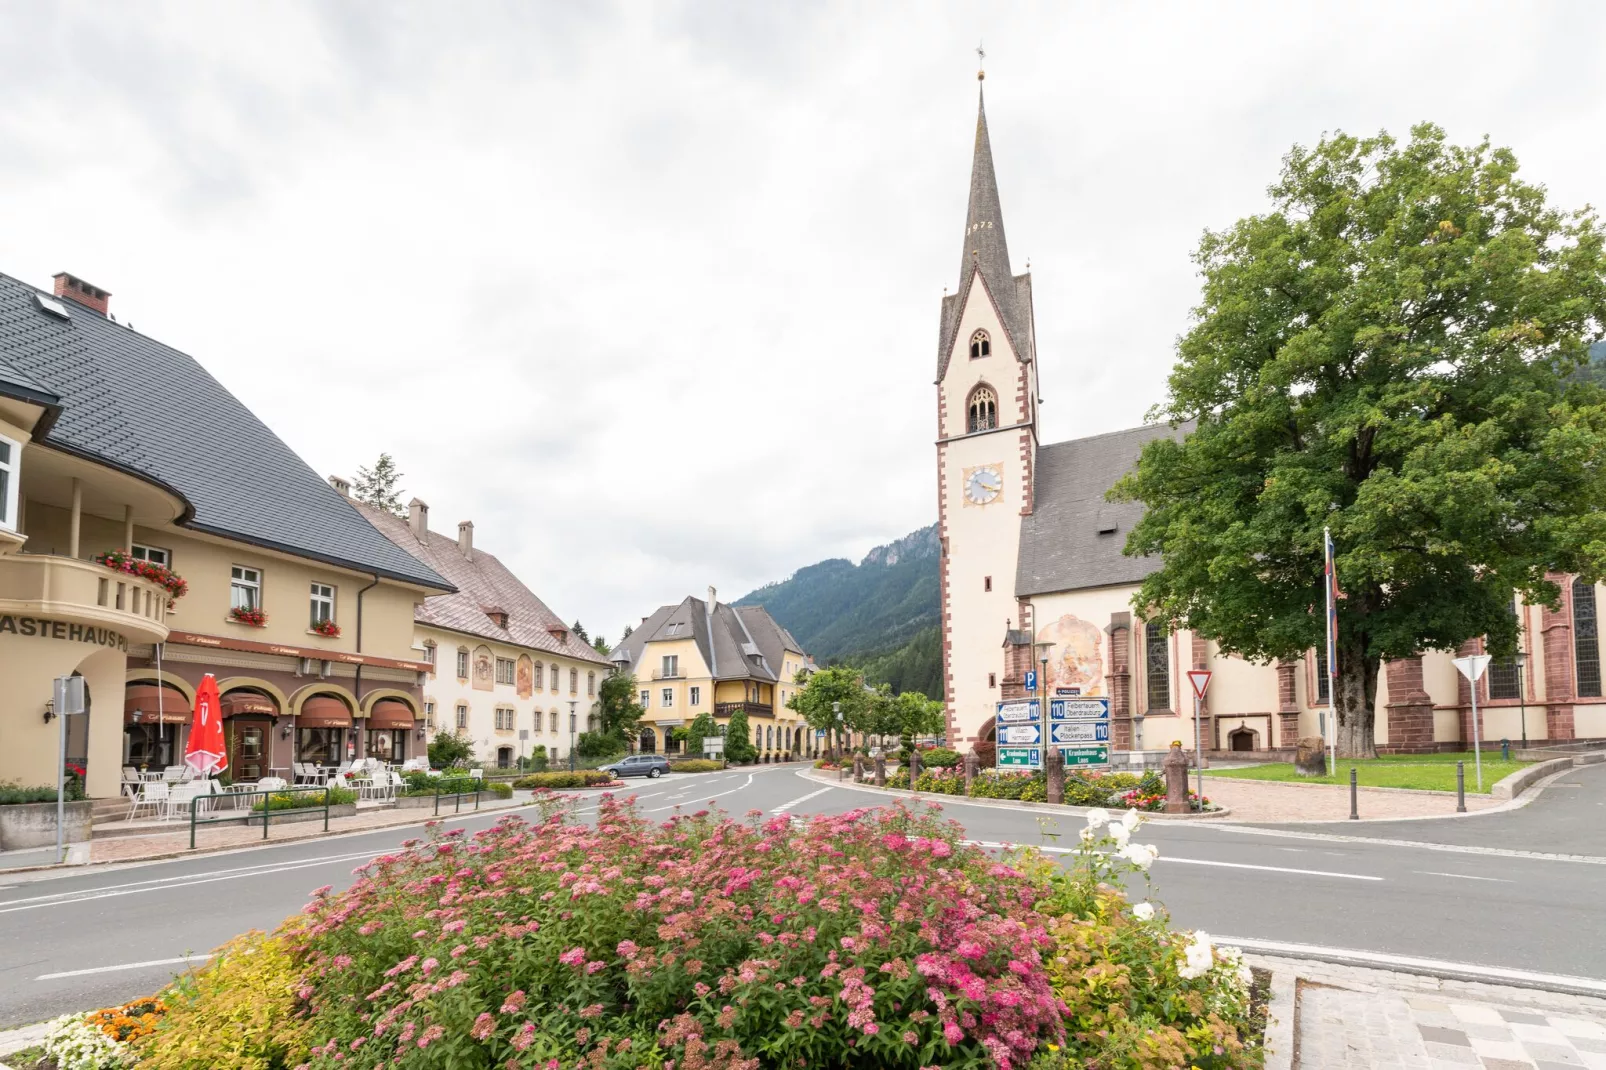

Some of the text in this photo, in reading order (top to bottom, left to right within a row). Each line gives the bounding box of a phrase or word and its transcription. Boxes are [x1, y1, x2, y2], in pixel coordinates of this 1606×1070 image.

[967, 221, 993, 235] 1972
[1027, 673, 1034, 685] P
[1030, 704, 1039, 717] 110
[1052, 703, 1063, 717] 110
[999, 729, 1008, 742] 111
[1096, 725, 1107, 739] 110
[1031, 751, 1037, 760] H
